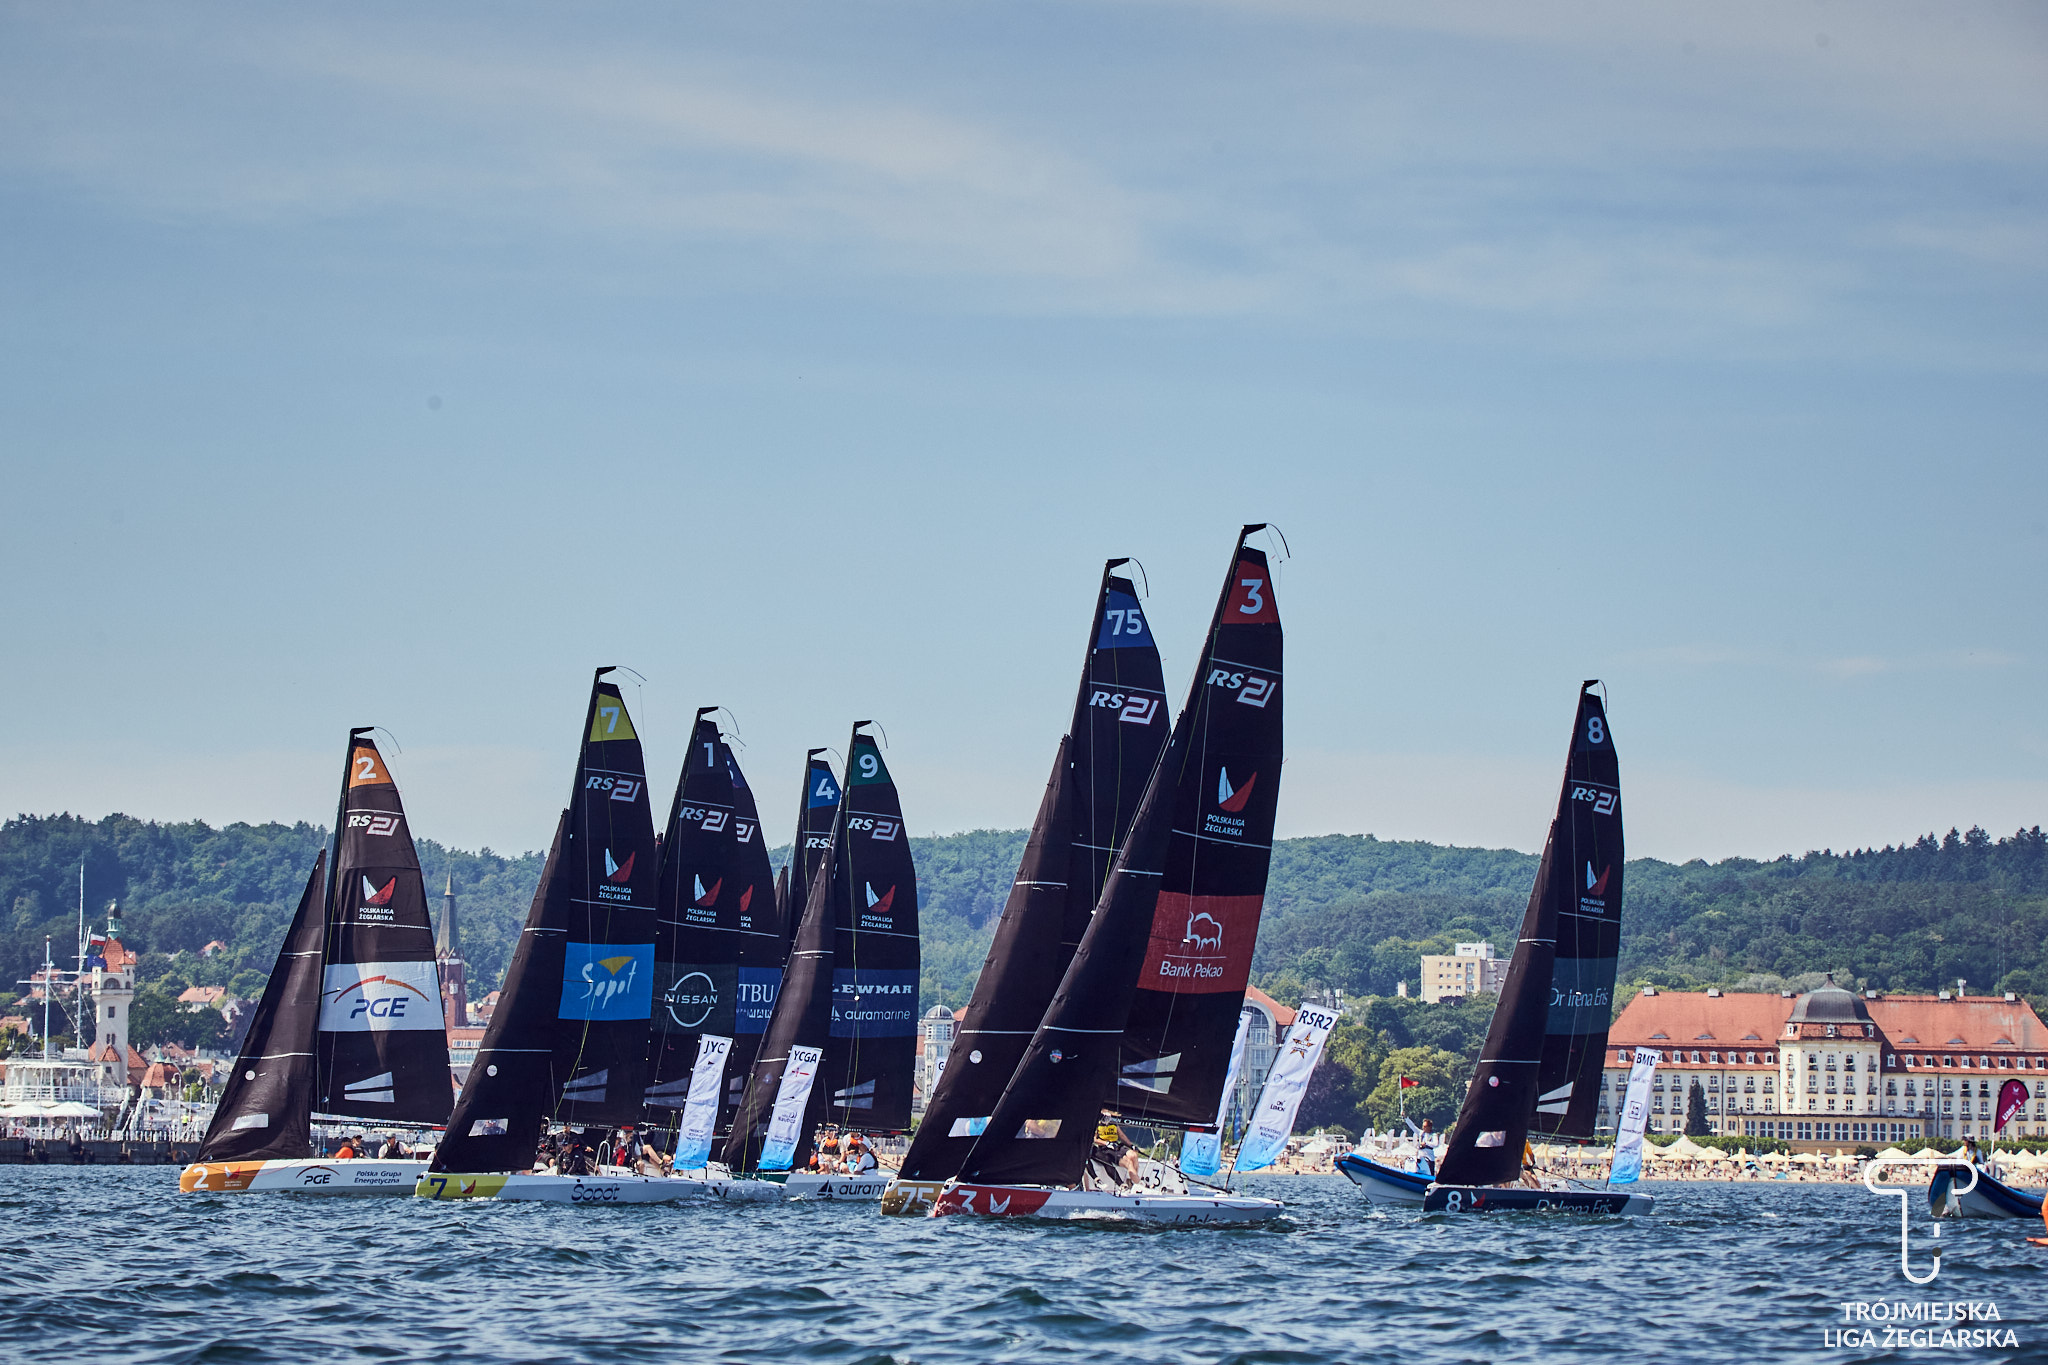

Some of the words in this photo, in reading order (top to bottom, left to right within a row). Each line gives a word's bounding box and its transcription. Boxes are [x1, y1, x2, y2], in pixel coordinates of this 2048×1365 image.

[1239, 578, 1263, 615] 3
[1106, 609, 1143, 636] 75
[600, 706, 620, 734] 7
[1587, 716, 1604, 743] 8
[703, 742, 713, 767] 1
[356, 756, 376, 779] 2
[859, 753, 878, 778] 9
[815, 778, 834, 800] 4
[1204, 822, 1243, 836] ŻEGLARSKA
[1207, 813, 1231, 825] POLSKA
[1232, 819, 1245, 827] LIGA
[805, 837, 834, 849] RS
[1160, 961, 1192, 977] Bank
[1193, 963, 1223, 978] Pekao
[580, 961, 637, 1010] Sopot
[737, 984, 774, 1003] TBU
[350, 997, 409, 1018] PGE
[664, 993, 718, 1004] NISSAN
[844, 1010, 911, 1020] auramarine
[1298, 1009, 1333, 1031] RSR2
[703, 1040, 725, 1054] JYC
[793, 1050, 818, 1063] YCGA
[1636, 1052, 1656, 1066] BMD
[193, 1166, 209, 1188] 2
[304, 1174, 331, 1185] PGE
[354, 1177, 400, 1185] Energetyczna
[380, 1170, 402, 1179] Grupa
[430, 1178, 447, 1200] 7
[839, 1184, 885, 1196] auram
[898, 1187, 934, 1213] 75
[958, 1190, 977, 1214] 3
[1446, 1190, 1462, 1213] 8
